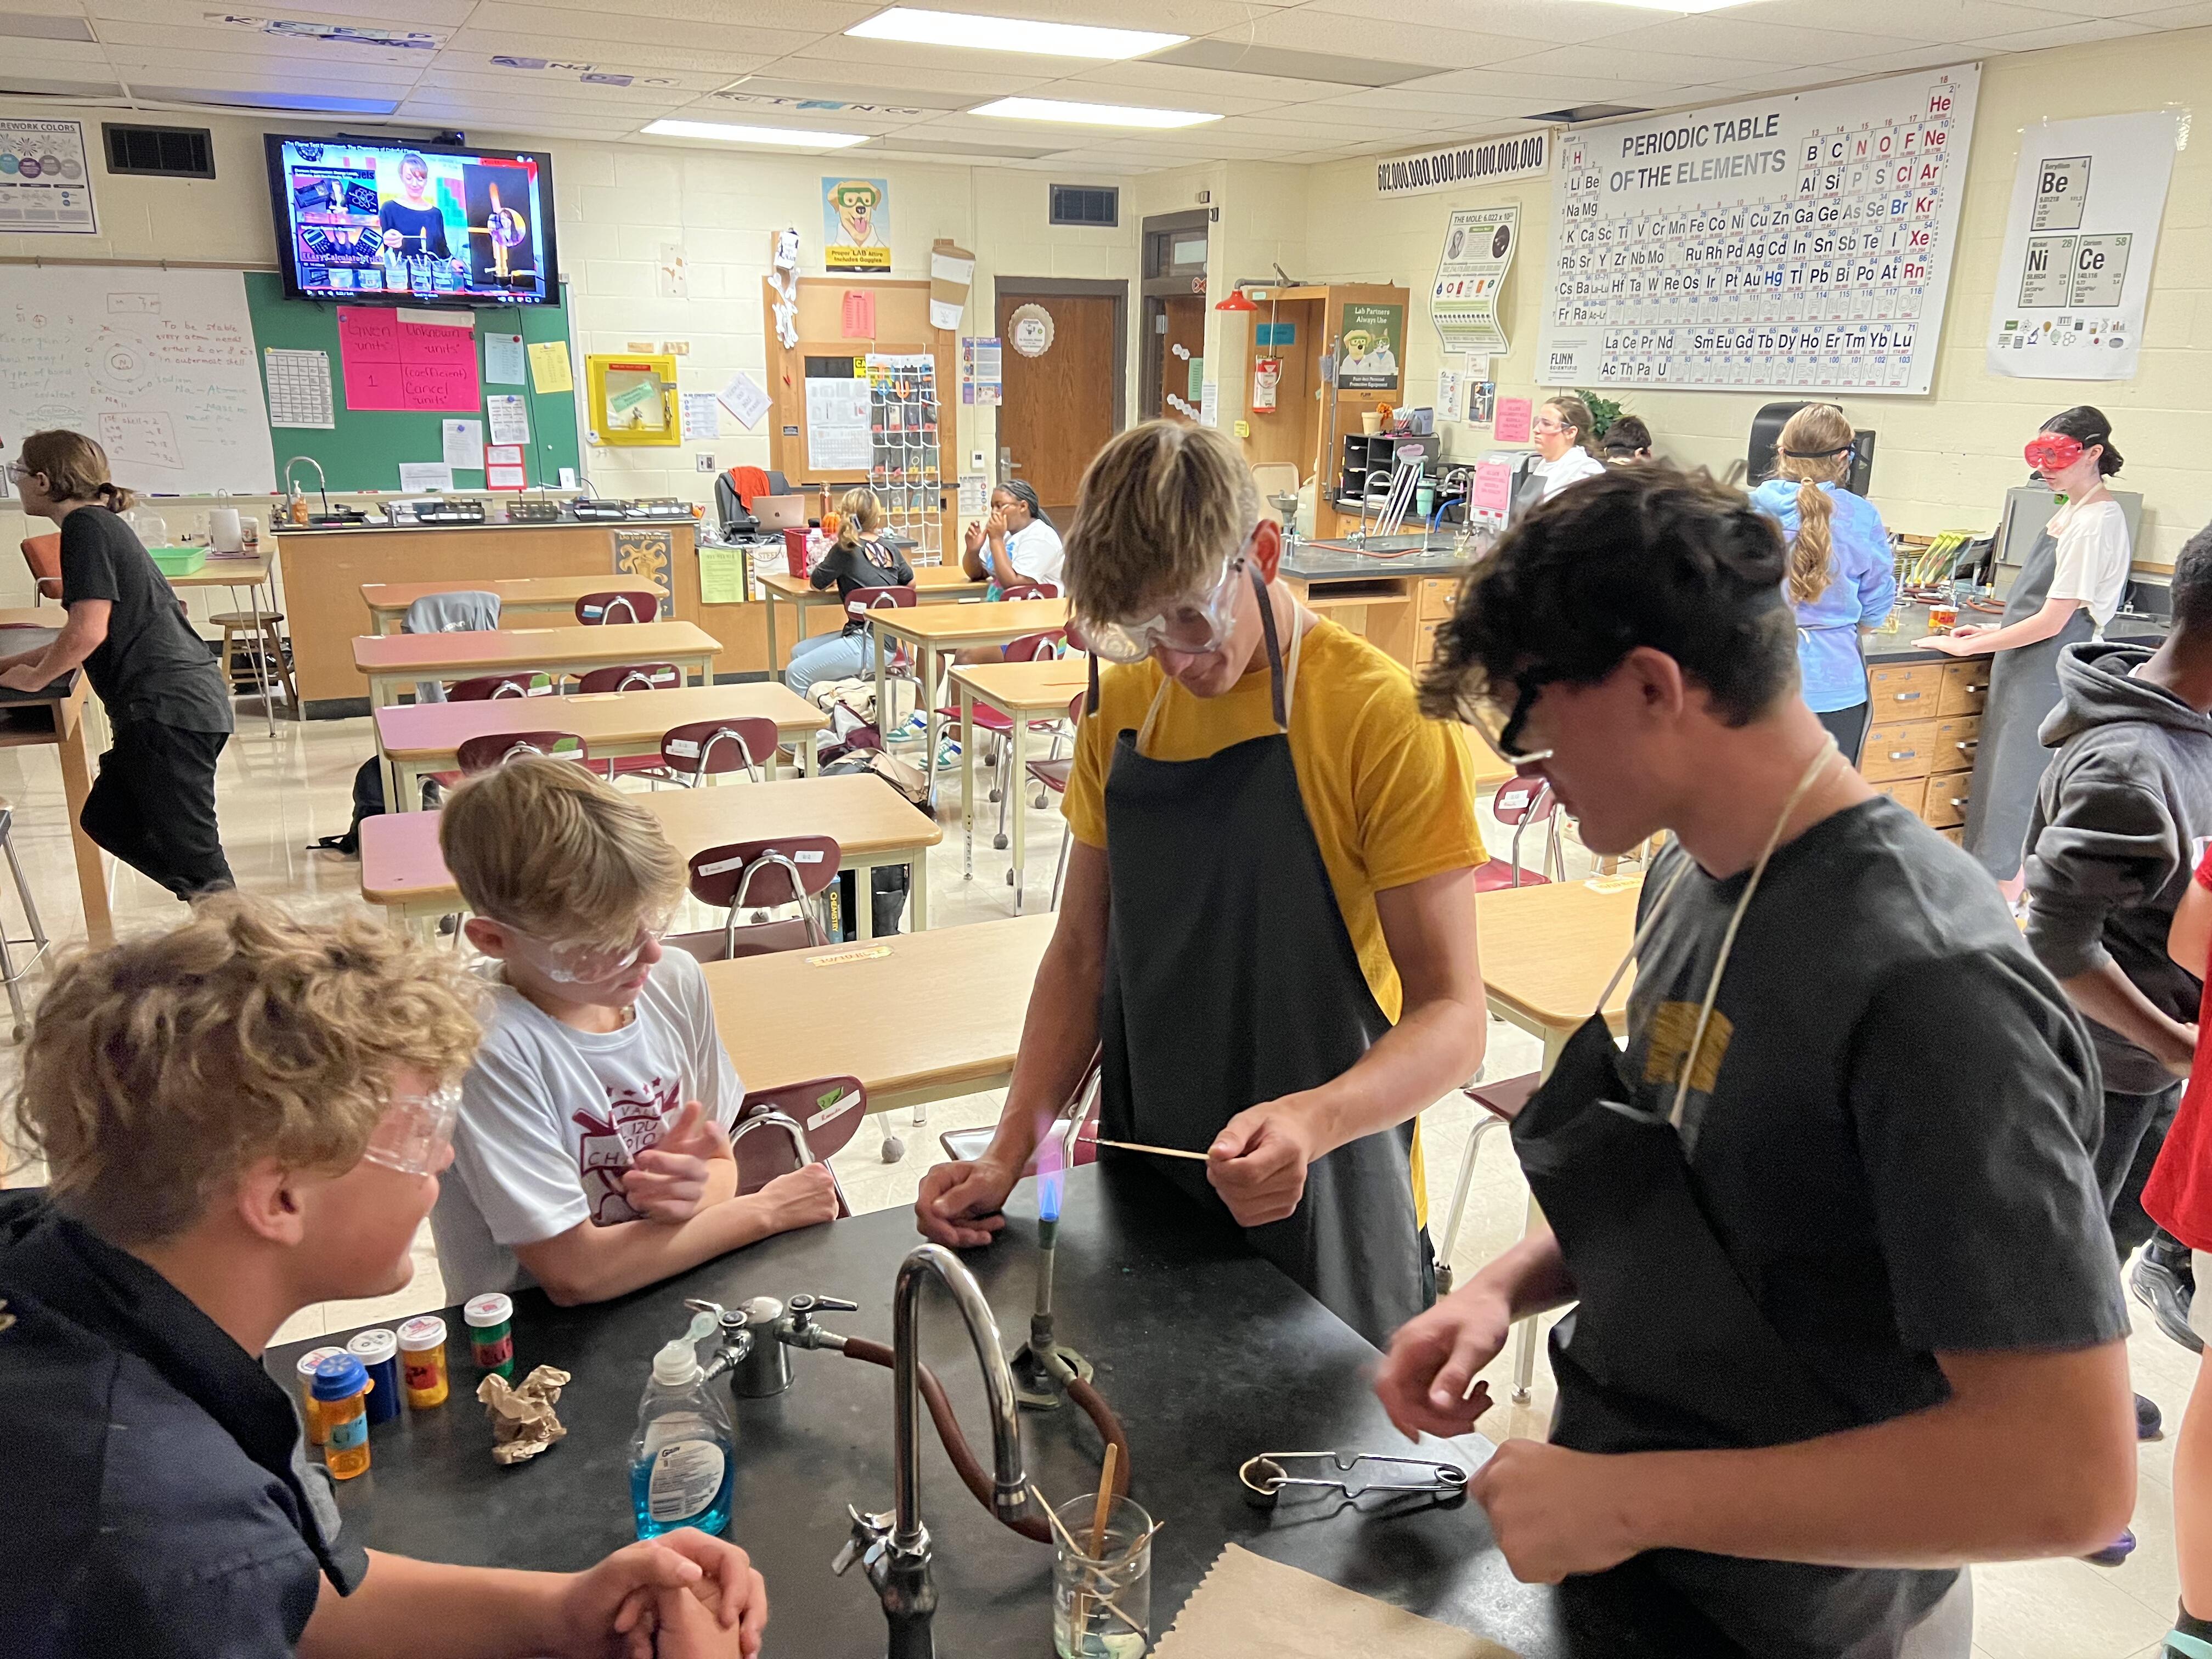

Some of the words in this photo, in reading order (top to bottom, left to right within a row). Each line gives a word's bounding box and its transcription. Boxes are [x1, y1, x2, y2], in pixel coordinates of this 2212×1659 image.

[1929, 95, 1951, 112] He
[1622, 125, 1709, 158] PERIODIC
[1713, 114, 1780, 144] TABLE
[1807, 146, 1818, 161] B
[1832, 143, 1843, 158] C
[1857, 140, 1867, 155] N
[1880, 136, 1891, 152] O
[1904, 133, 1915, 149] F
[1925, 130, 1945, 146] Ne
[1573, 151, 1581, 164] H
[1571, 178, 1580, 190] Li
[1585, 176, 1599, 189] Be
[1801, 177, 1815, 192] Al
[1825, 174, 1839, 190] Si
[1875, 169, 1884, 184] S
[1897, 166, 1912, 182] Cl
[1920, 164, 1939, 179] Ar
[1610, 170, 1635, 192] OF
[1638, 165, 1672, 188] THE
[1677, 149, 1785, 184] ELEMENTS
[2041, 172, 2068, 193] Be
[1567, 205, 1579, 217] Na
[1582, 202, 1598, 216] Mg
[1567, 230, 1575, 242] K
[1581, 229, 1594, 242] Ca
[1598, 228, 1612, 240] Sc
[1618, 226, 1628, 239] Ti
[1638, 224, 1645, 237] V
[1652, 222, 1665, 235] Cr
[1669, 221, 1685, 234] Mn
[1690, 219, 1704, 233] Fe
[1709, 217, 1725, 230] Co
[1731, 215, 1744, 229] Ni
[1751, 213, 1768, 227] Cu
[1772, 211, 1789, 225] Zn
[1795, 208, 1813, 223] Ga
[1818, 206, 1838, 221] Ge
[1842, 204, 1860, 219] As
[1866, 202, 1884, 217] Se
[1891, 199, 1908, 215] Br
[1915, 197, 1934, 213] Kr
[1562, 257, 1575, 269] Rb
[1579, 255, 1591, 268] Sr
[1599, 254, 1606, 266] Y
[1615, 253, 1627, 266] Zr
[1630, 251, 1645, 264] Nb
[1647, 250, 1663, 263] Mo
[1686, 247, 1702, 261] Ru
[1706, 246, 1722, 259] Rh
[1726, 244, 1743, 258] Pd
[1746, 243, 1764, 258] Ag
[1768, 240, 1786, 255] Cd
[1814, 238, 1832, 252] Sn
[1838, 236, 1856, 251] Sb
[1863, 234, 1878, 249] Te
[1909, 230, 1929, 246] Xe
[2062, 239, 2073, 248] 28
[2115, 237, 2127, 246] 58
[2029, 250, 2049, 271] Ni
[2079, 249, 2104, 270] Ce
[1560, 283, 1572, 295] Cs
[1577, 281, 1589, 294] Ba
[1612, 279, 1624, 292] Hf
[1630, 279, 1641, 291] Ta
[1649, 278, 1658, 291] W
[1664, 277, 1679, 290] Re
[1683, 276, 1699, 289] Os
[1725, 274, 1737, 287] Pt
[1743, 273, 1760, 286] Au
[1765, 271, 1782, 286] Hg
[1810, 269, 1829, 283] Pb
[1836, 267, 1850, 282] Bi
[1857, 266, 1874, 281] Po
[1881, 264, 1897, 279] At
[1903, 263, 1924, 279] Rn
[1559, 308, 1569, 320] Fr
[1574, 307, 1587, 319] Ra
[348, 319, 390, 337] Given
[407, 323, 459, 337] Unknown
[1605, 336, 1618, 349] La
[1623, 336, 1636, 349] Ce
[1641, 336, 1653, 349] Pr
[1657, 335, 1673, 348] Nd
[1694, 335, 1713, 348] Sm
[1716, 335, 1731, 348] Eu
[1735, 334, 1753, 348] Gd
[1758, 334, 1773, 348] Tb
[1779, 334, 1796, 350] Dy
[1800, 334, 1819, 348] Ho
[1825, 334, 1840, 348] Er
[1845, 333, 1865, 347] Tm
[1870, 332, 1887, 347] Yb
[1893, 332, 1911, 347] Lu
[1550, 353, 1573, 365] FLINN
[1601, 363, 1616, 375] Ac
[1621, 363, 1632, 375] Th
[1637, 363, 1650, 375] Pa
[1658, 363, 1666, 375] U
[406, 381, 448, 395] Cancel
[830, 891, 838, 932] CHEMISTRY
